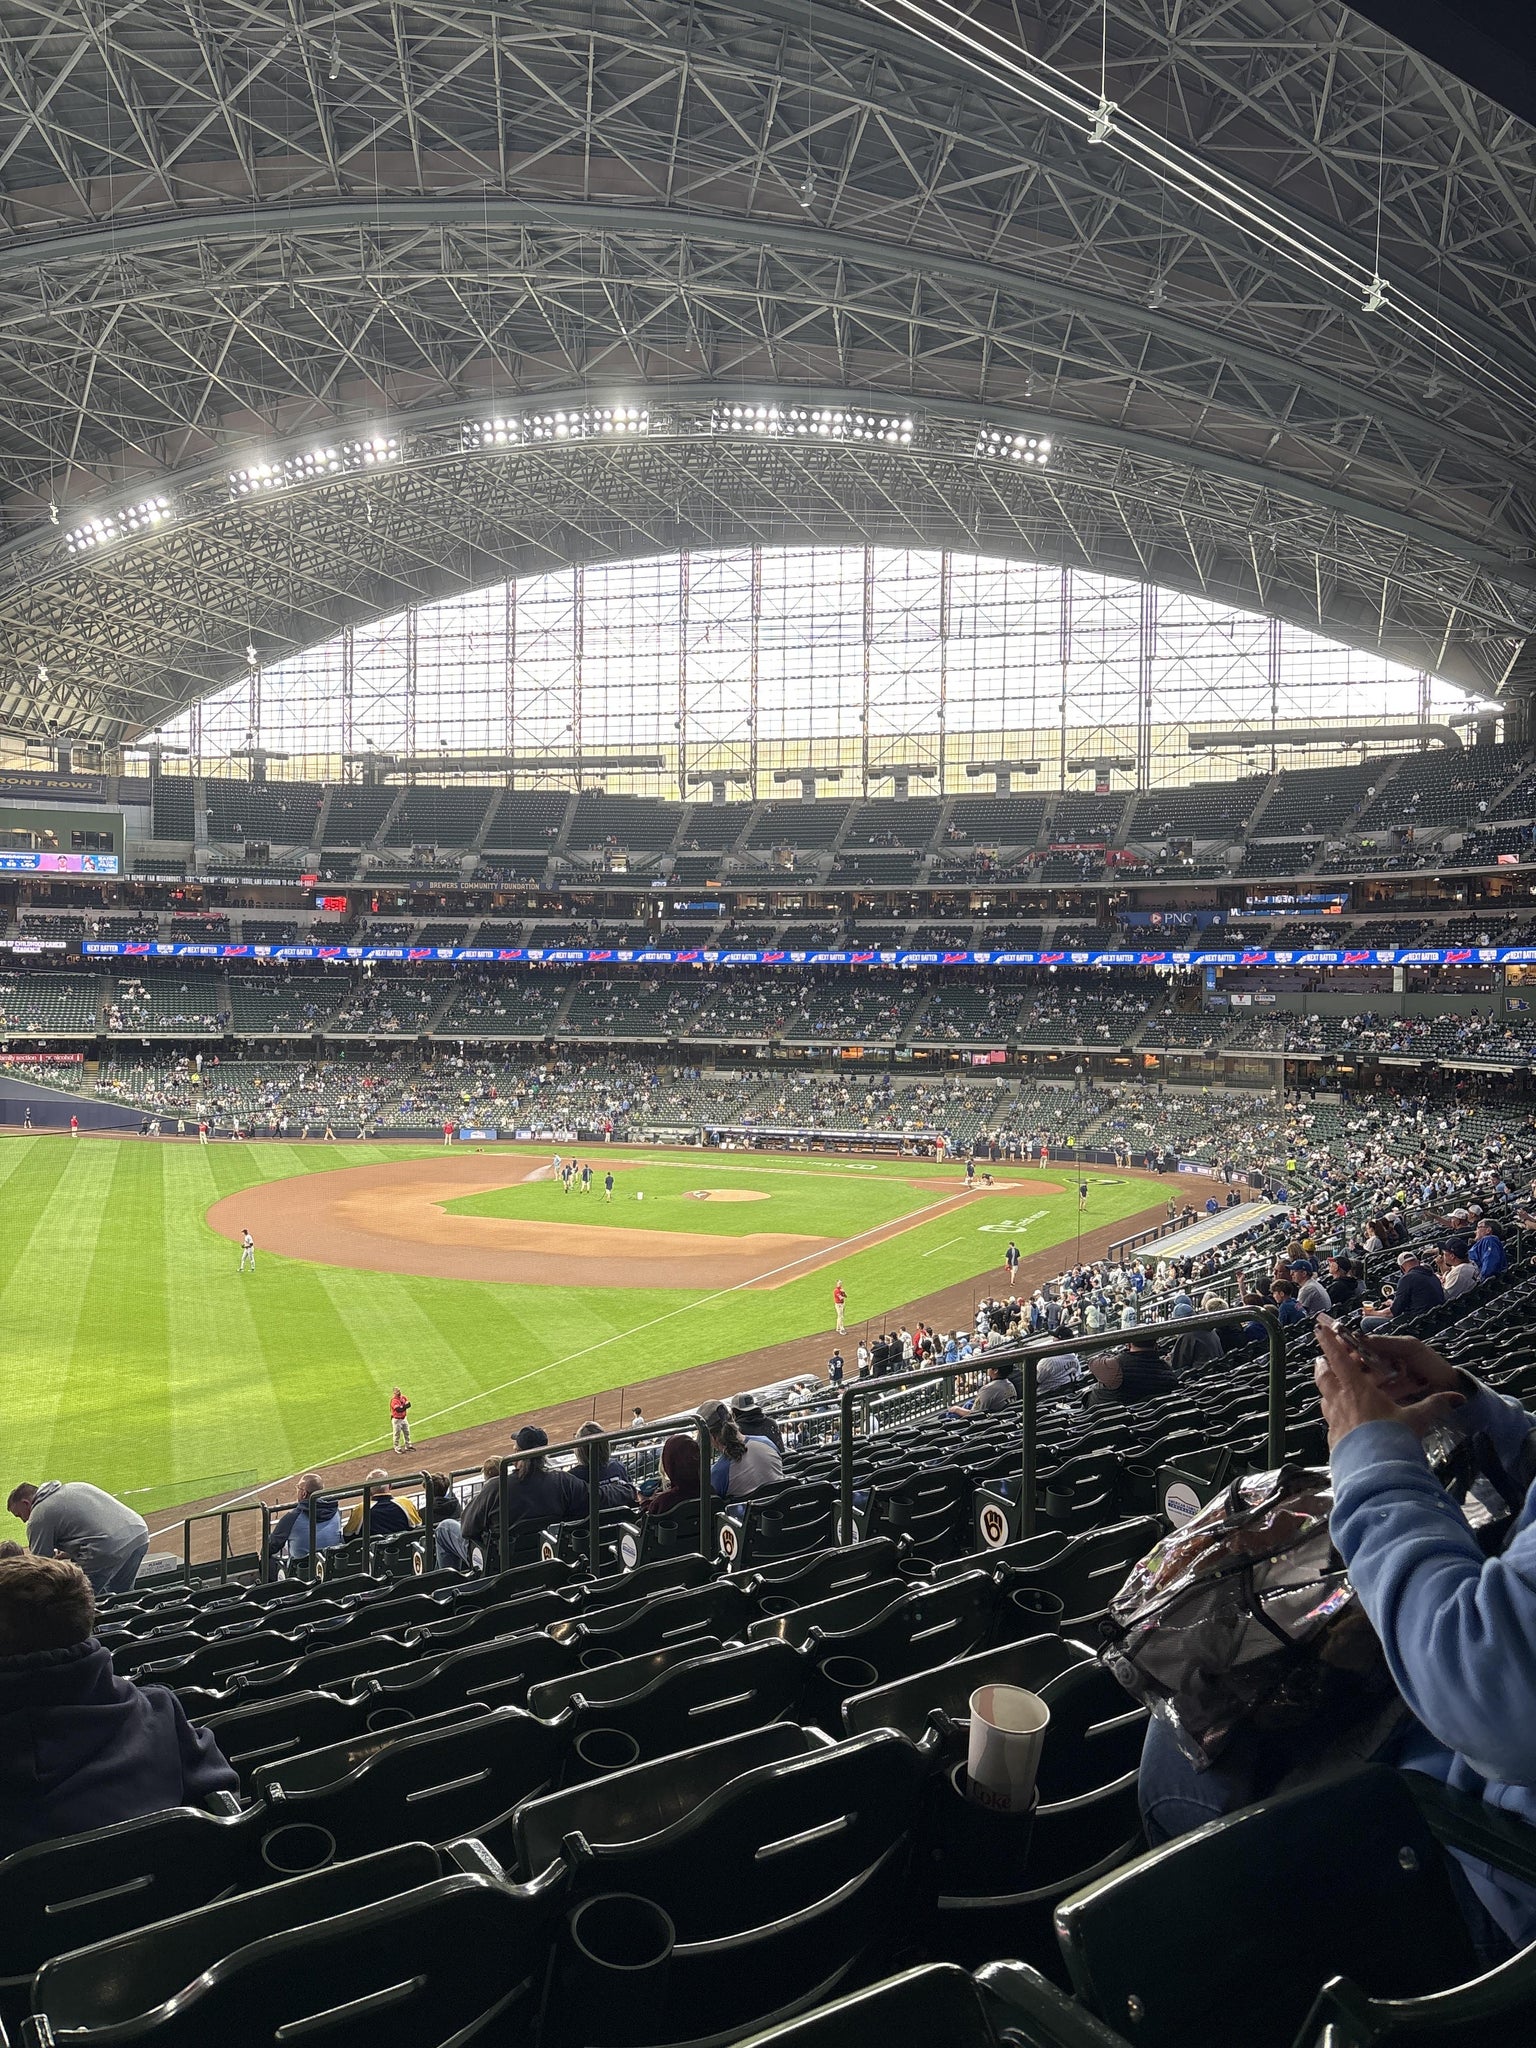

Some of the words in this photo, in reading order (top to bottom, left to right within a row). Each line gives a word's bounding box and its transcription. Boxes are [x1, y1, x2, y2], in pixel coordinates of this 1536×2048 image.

[0, 777, 43, 786] RONT
[47, 780, 93, 789] ROW!
[429, 881, 458, 889] BREWERS
[460, 881, 498, 890] COMMUNITY
[500, 882, 540, 890] FOUNDATION
[1164, 913, 1192, 924] PNC
